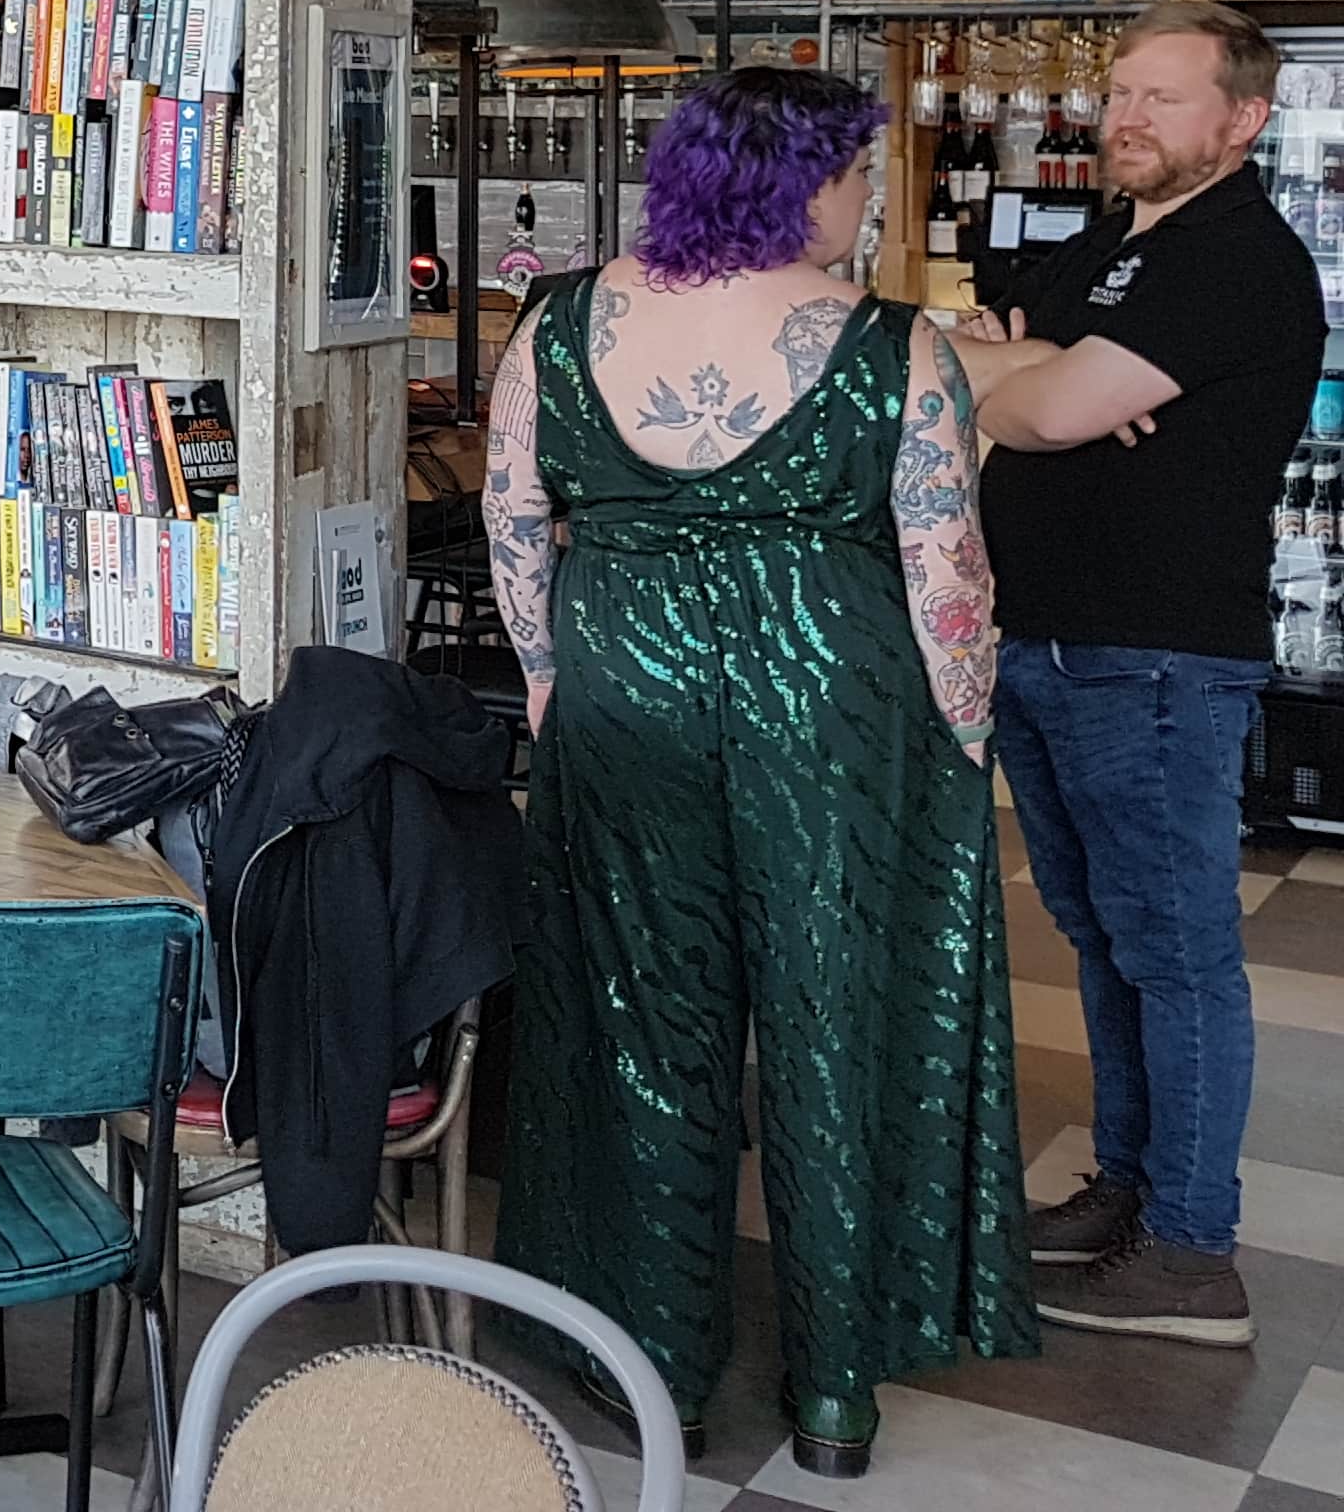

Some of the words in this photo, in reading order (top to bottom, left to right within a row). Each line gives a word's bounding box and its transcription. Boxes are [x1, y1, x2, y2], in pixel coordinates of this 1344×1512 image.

[159, 119, 175, 145] THE
[156, 151, 173, 198] WIVES
[176, 428, 232, 443] PATTERSON
[188, 418, 220, 432] JAMES
[179, 440, 236, 466] MURDER
